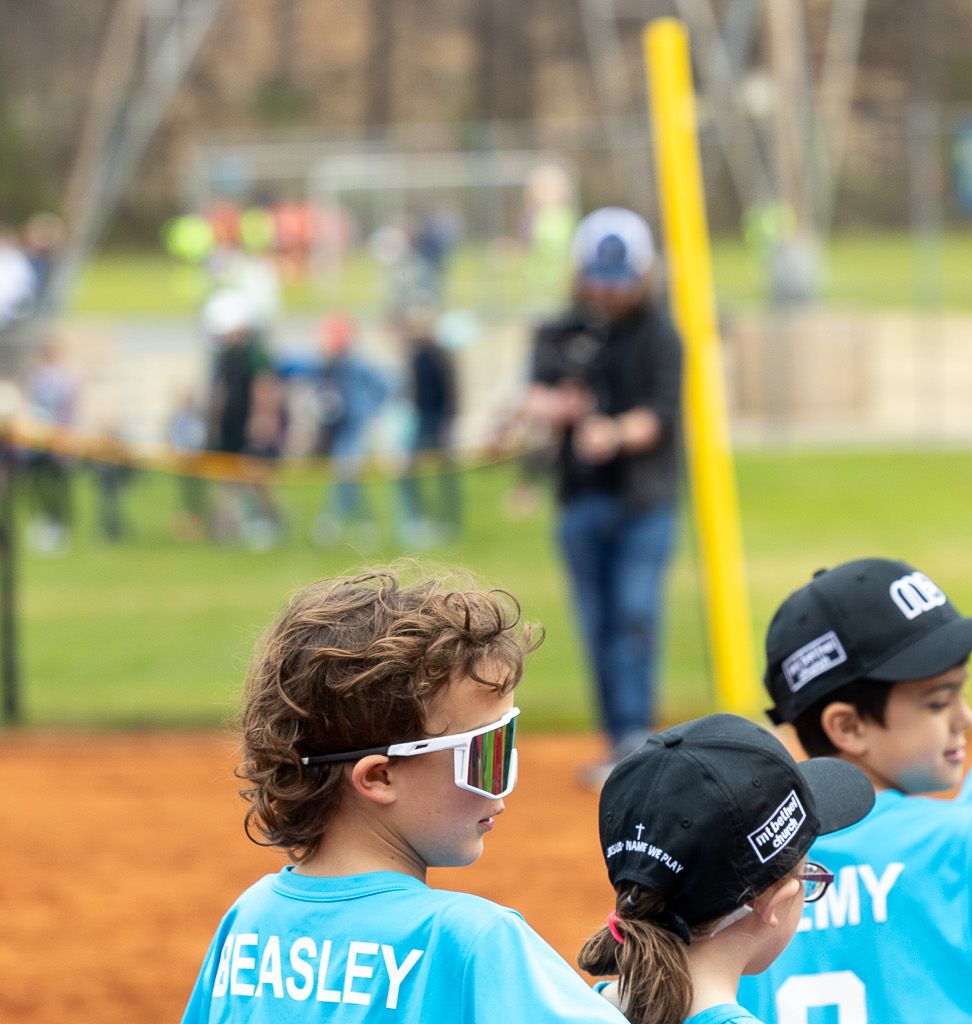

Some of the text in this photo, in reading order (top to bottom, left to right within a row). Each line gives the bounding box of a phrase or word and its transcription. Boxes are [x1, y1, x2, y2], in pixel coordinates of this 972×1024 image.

[770, 797, 798, 833] bethel
[773, 817, 798, 848] church
[625, 840, 648, 853] NAME
[648, 845, 662, 860] WE
[660, 853, 684, 874] PLAY
[212, 933, 425, 1010] BEASLEY
